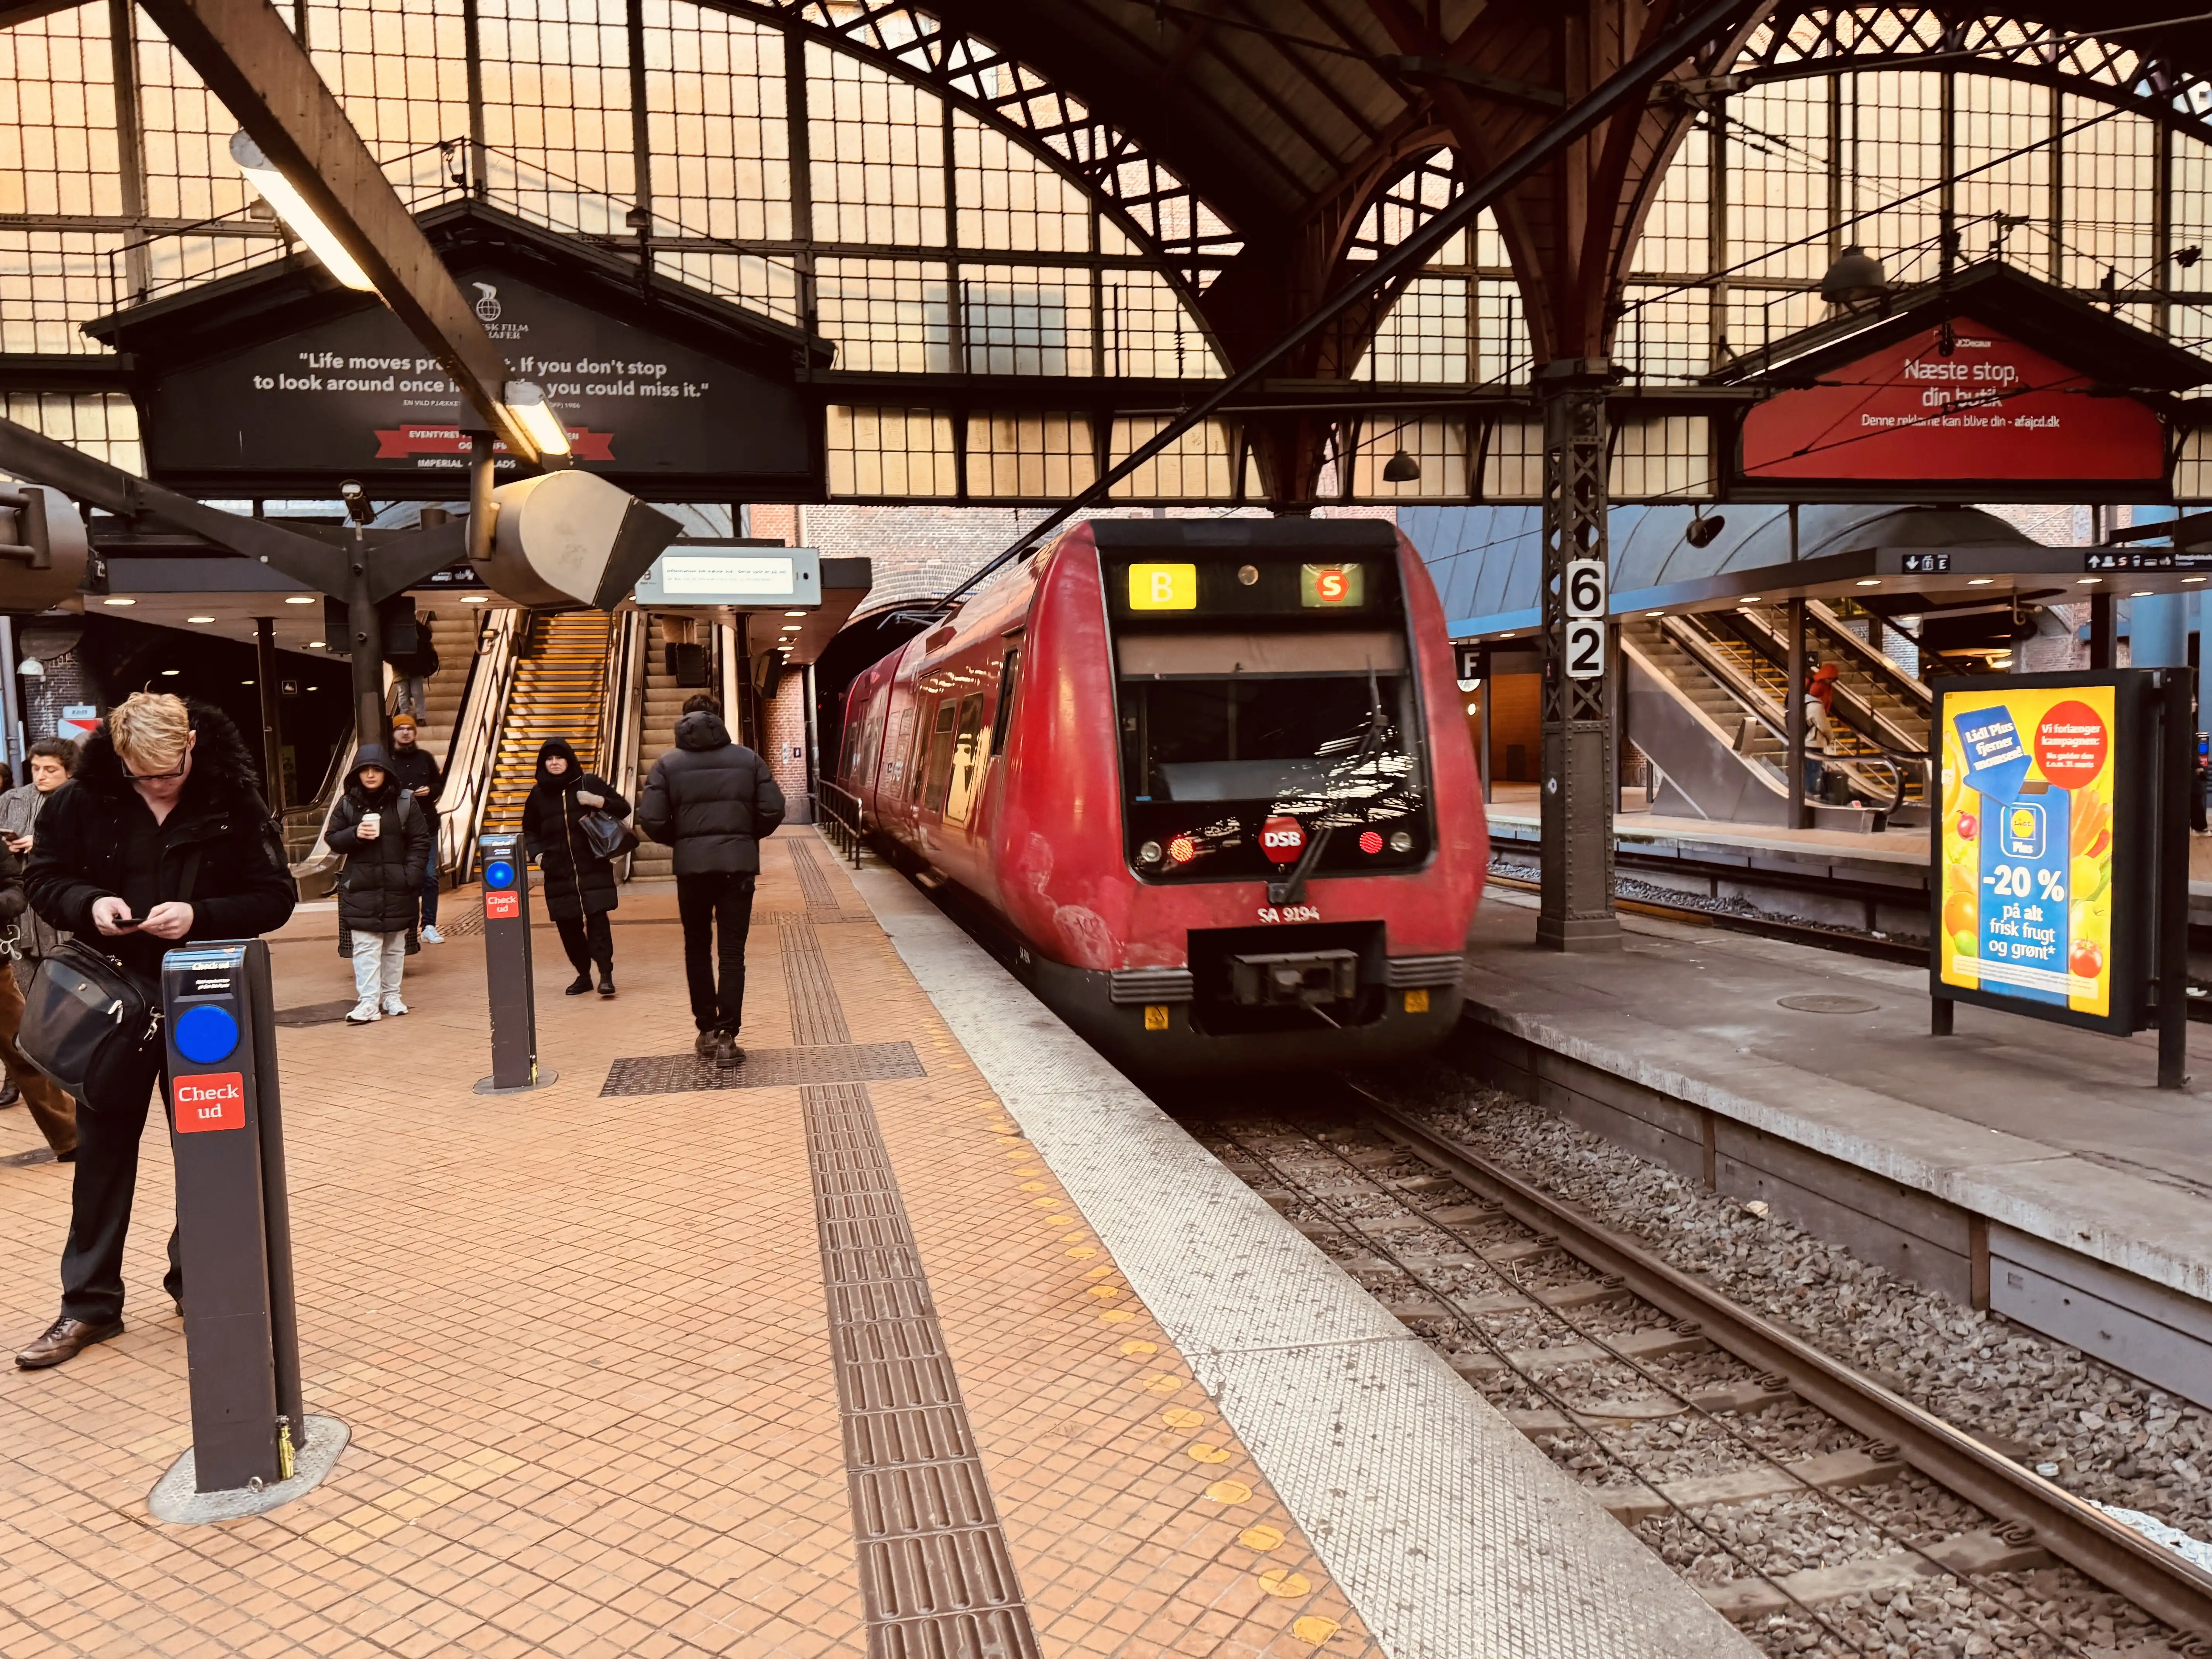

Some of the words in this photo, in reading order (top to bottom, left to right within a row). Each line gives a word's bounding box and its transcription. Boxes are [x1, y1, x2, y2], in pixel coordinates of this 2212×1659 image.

[1956, 338, 1992, 347] JCDecaux
[349, 357, 410, 370] moves
[521, 356, 534, 372] If
[537, 361, 572, 376] you
[576, 358, 624, 374] don't
[628, 363, 667, 379] stop
[1905, 358, 1968, 380] Næste
[1972, 361, 2019, 387] stop,
[253, 375, 274, 390] to
[280, 374, 323, 391] look
[327, 376, 394, 392] around
[400, 380, 445, 393] once
[546, 383, 580, 398] you
[586, 380, 634, 396] could
[640, 381, 679, 397] miss
[1922, 386, 1950, 407] din
[1862, 414, 1895, 426] Denne
[1942, 415, 1961, 427] kan
[1963, 415, 1989, 427] blive
[1990, 415, 2006, 427] din
[417, 459, 464, 468] IMPERIAL
[1939, 559, 1947, 569] E
[1151, 572, 1173, 603] B
[1323, 575, 1341, 596] S
[1571, 568, 1601, 611] 6
[1571, 627, 1600, 671] 2
[1464, 652, 1480, 677] F
[1965, 726, 1990, 743] Lidl
[1988, 721, 2014, 737] Plus
[2041, 724, 2052, 734] Vi
[1975, 736, 2013, 757] fjerner
[1264, 831, 1301, 847] DSB
[2012, 841, 2033, 854] Plus
[1983, 864, 2031, 897] -20
[2038, 869, 2064, 902] %
[488, 896, 517, 905] Check
[496, 905, 508, 913] ud
[1257, 908, 1280, 923] SA
[1283, 906, 1320, 922] 9194
[2002, 902, 2021, 921] på
[2024, 905, 2043, 922] alt
[1989, 918, 2019, 937] frisk
[2022, 922, 2056, 945] frugt
[1989, 940, 2007, 957] og
[179, 1084, 239, 1102] Check
[198, 1103, 223, 1119] ud
